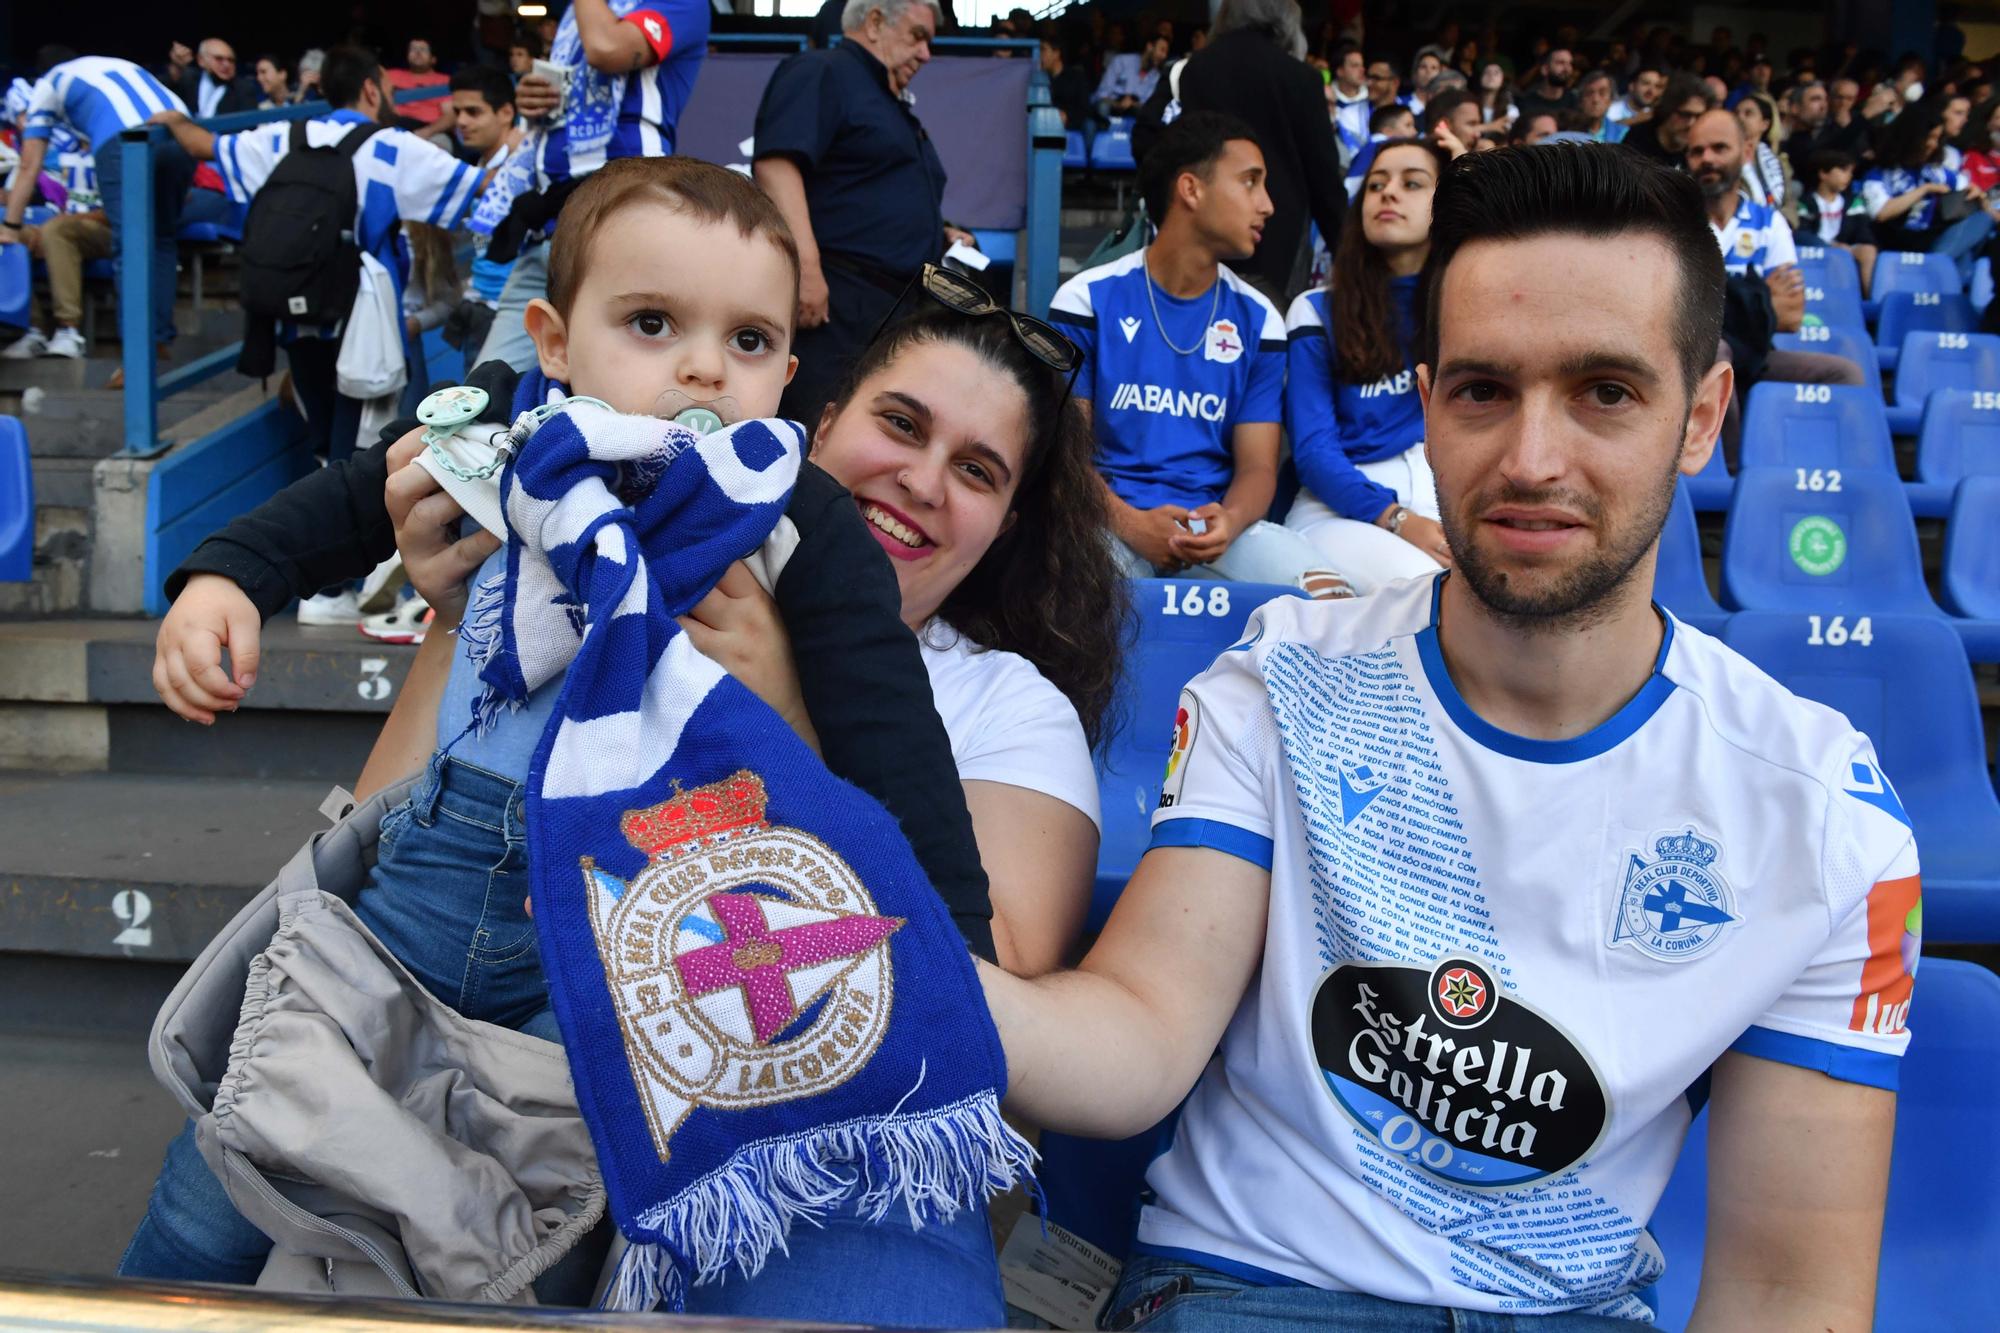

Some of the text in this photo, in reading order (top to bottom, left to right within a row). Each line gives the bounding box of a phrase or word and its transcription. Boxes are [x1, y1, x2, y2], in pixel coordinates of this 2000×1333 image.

[1799, 326, 1830, 341] 158
[1938, 333, 1969, 349] 156
[1794, 384, 1831, 403] 160
[1795, 468, 1842, 492] 162
[1162, 584, 1231, 617] 168
[1807, 615, 1873, 647] 164
[357, 658, 392, 700] 3
[1402, 694, 1422, 704] CON
[1335, 713, 1351, 723] DAS
[1353, 718, 1380, 730] EDADES
[1382, 725, 1398, 735] QUE
[1400, 728, 1408, 736] AS
[1411, 729, 1435, 745] VOSAS
[1350, 727, 1377, 740] DONDE
[1402, 740, 1431, 756] XIGANTE
[1419, 722, 1430, 732] OS
[1330, 731, 1403, 759] DA BOA NAZÓN DE
[1328, 741, 1449, 786] COSTA AO RAIO
[1377, 771, 1454, 801] AS COPAS DE
[1411, 793, 1458, 816] MONÓTONO
[1386, 810, 1468, 844] DES A ESQUECEMENTO
[1432, 814, 1463, 830] CONFÍN
[1363, 827, 1477, 874] NOSA VOZ ENTENDEN CON
[1376, 820, 1473, 859] DO TEU SONO FOGAR DE
[1377, 859, 1486, 904] NON OS OS
[1382, 848, 1476, 887] MÁIS SÓO OS IÑORANTES
[1342, 862, 1495, 933] FIN DONDE XIGANTE A
[1383, 874, 1490, 919] DAS EDADES QUE AS VOSAS
[1634, 865, 1719, 902] REAL CLUB DEPORTIVO
[1332, 871, 1455, 931] A REDENZÓN DA NAZÓN DE
[112, 889, 152, 946] 2
[1332, 897, 1442, 951] PRÁCIDO LUAR? QUE DIN AS
[1365, 899, 1506, 961] NA COSTA AO RAIO
[1360, 925, 1410, 951] CO SEU BEN
[1360, 938, 1401, 960] CINGUIDO
[1651, 934, 1704, 950] LA CORUÑA
[1500, 967, 1512, 976] DE
[1353, 983, 1568, 1112] Estrella
[1348, 1028, 1537, 1158] Galicia
[1381, 1114, 1453, 1168] 0,0
[1356, 1144, 1384, 1163] TEMPOS
[1385, 1159, 1404, 1172] SON
[1405, 1169, 1448, 1196] CHEGADOS
[1450, 1192, 1468, 1204] DOS
[1360, 1158, 1408, 1189] VAGUEDADES
[1408, 1185, 1450, 1209] CUMPRIDO
[1451, 1205, 1464, 1216] FIN
[1362, 1174, 1383, 1190] NOSA
[1387, 1187, 1403, 1201] VOZ
[1405, 1197, 1436, 1218] PREGOA
[1544, 1205, 1564, 1214] ALTAS
[1566, 1200, 1592, 1211] COPAS
[1595, 1197, 1606, 1205] DE
[1557, 1188, 1592, 1199] AO RAIO
[1477, 1206, 1619, 1233] CO COMPASADO MONÓTONO
[1602, 1216, 1633, 1229] CONFÍN
[1549, 1240, 1566, 1249] NON
[1566, 1237, 1581, 1247] DES
[1567, 1245, 1618, 1260] DO TEU SONO
[1092, 1254, 1109, 1270] un
[1450, 1250, 1497, 1282] VAGUEDADES
[1450, 1266, 1472, 1282] NOSA
[1476, 1252, 1555, 1299] SON CHEGADOS DOS
[1565, 1261, 1602, 1272] NOSA VOZ
[1499, 1300, 1513, 1308] DOS
